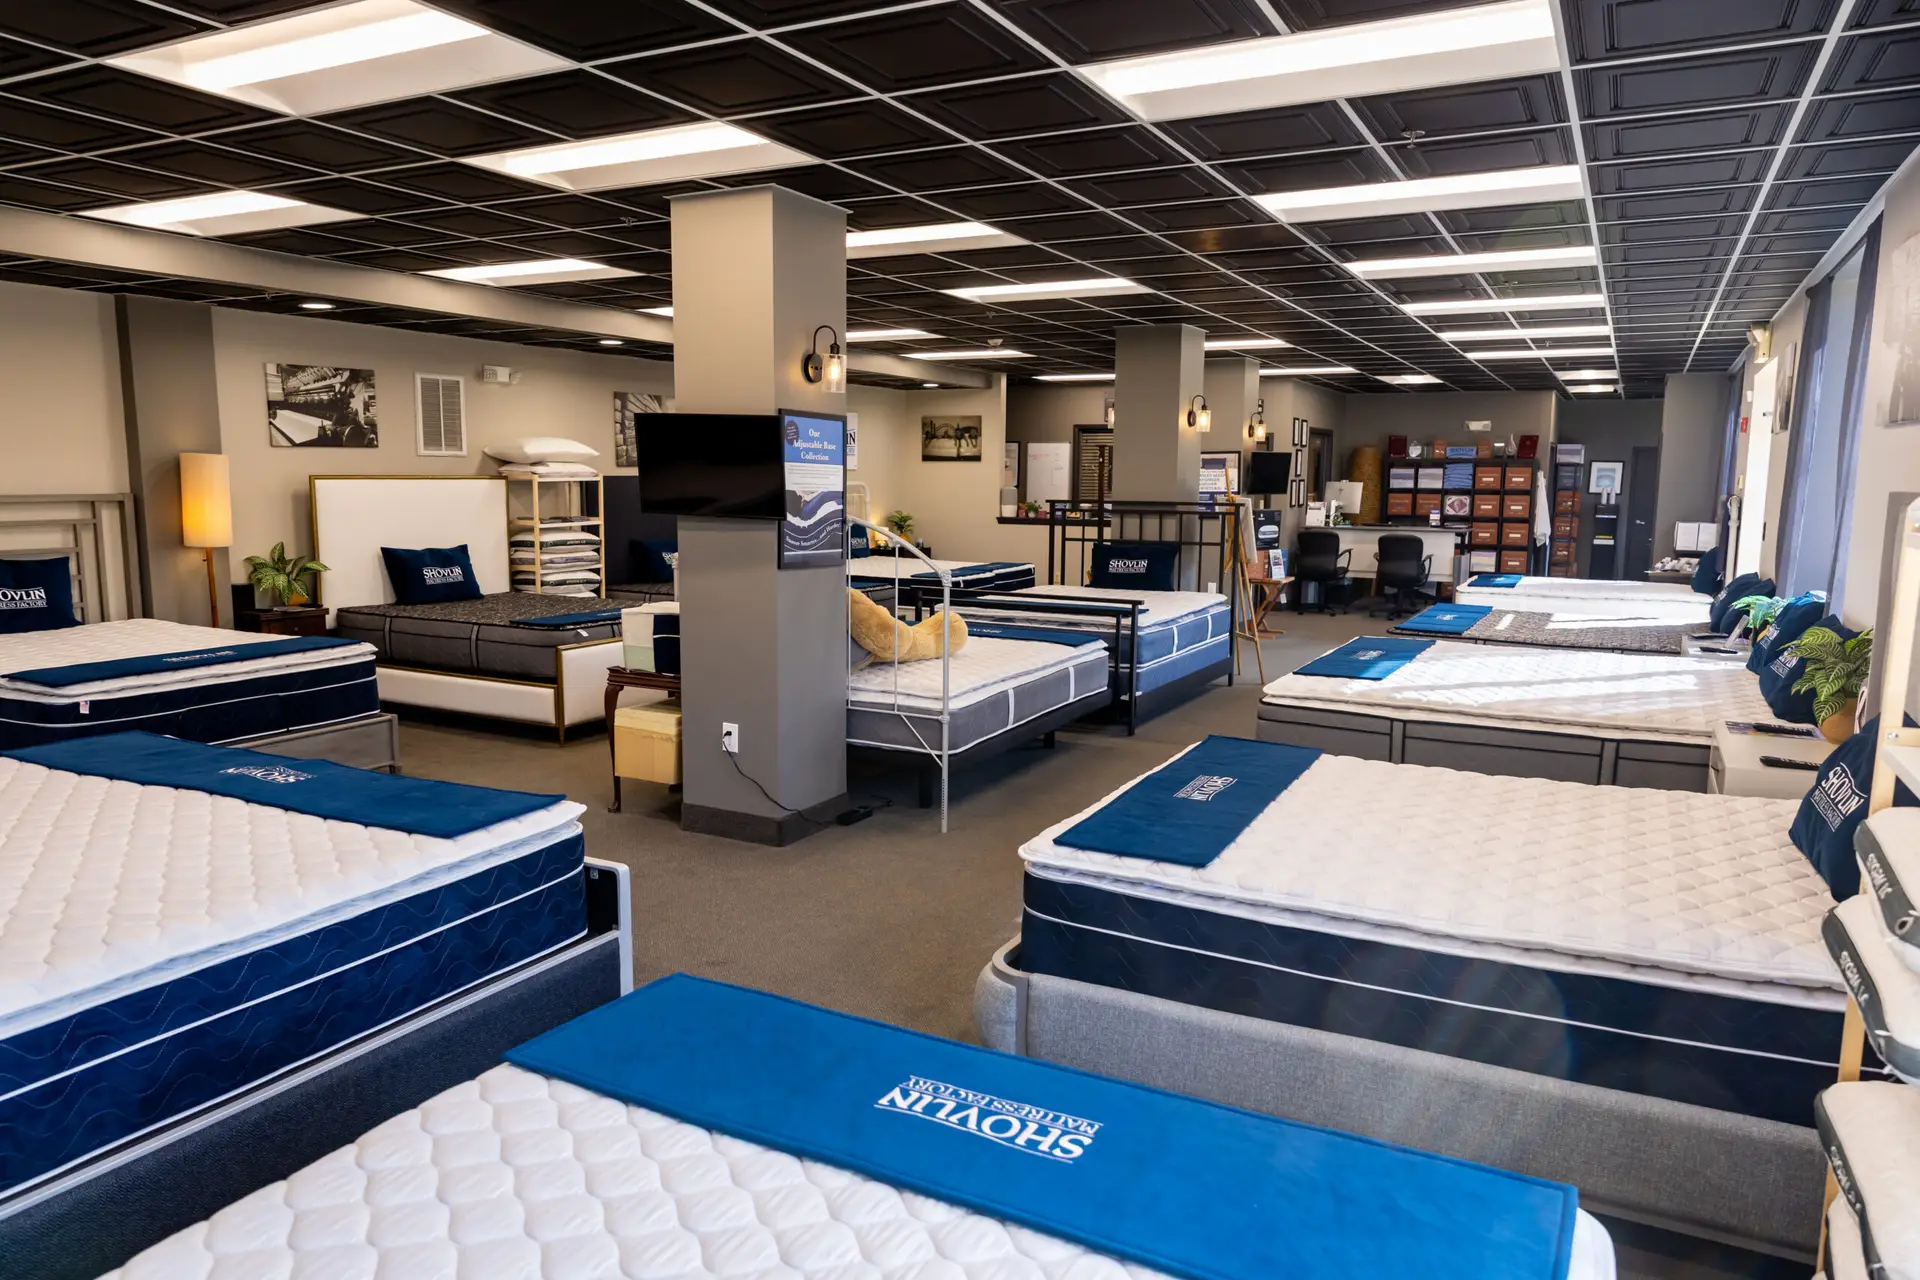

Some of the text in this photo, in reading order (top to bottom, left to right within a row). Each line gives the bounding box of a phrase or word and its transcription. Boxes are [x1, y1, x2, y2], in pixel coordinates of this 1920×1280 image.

[808, 428, 820, 437] Our
[793, 439, 836, 450] Adjustable Base
[800, 451, 829, 461] Collection
[1109, 559, 1148, 568] SHOVLIN
[423, 567, 462, 579] SHOVLIN
[0, 588, 46, 601] OVLIN
[1821, 766, 1865, 817] SHOVLIN
[903, 1077, 1100, 1136] MATTRESS FACTORY
[878, 1086, 1093, 1159] SHOVLIN
